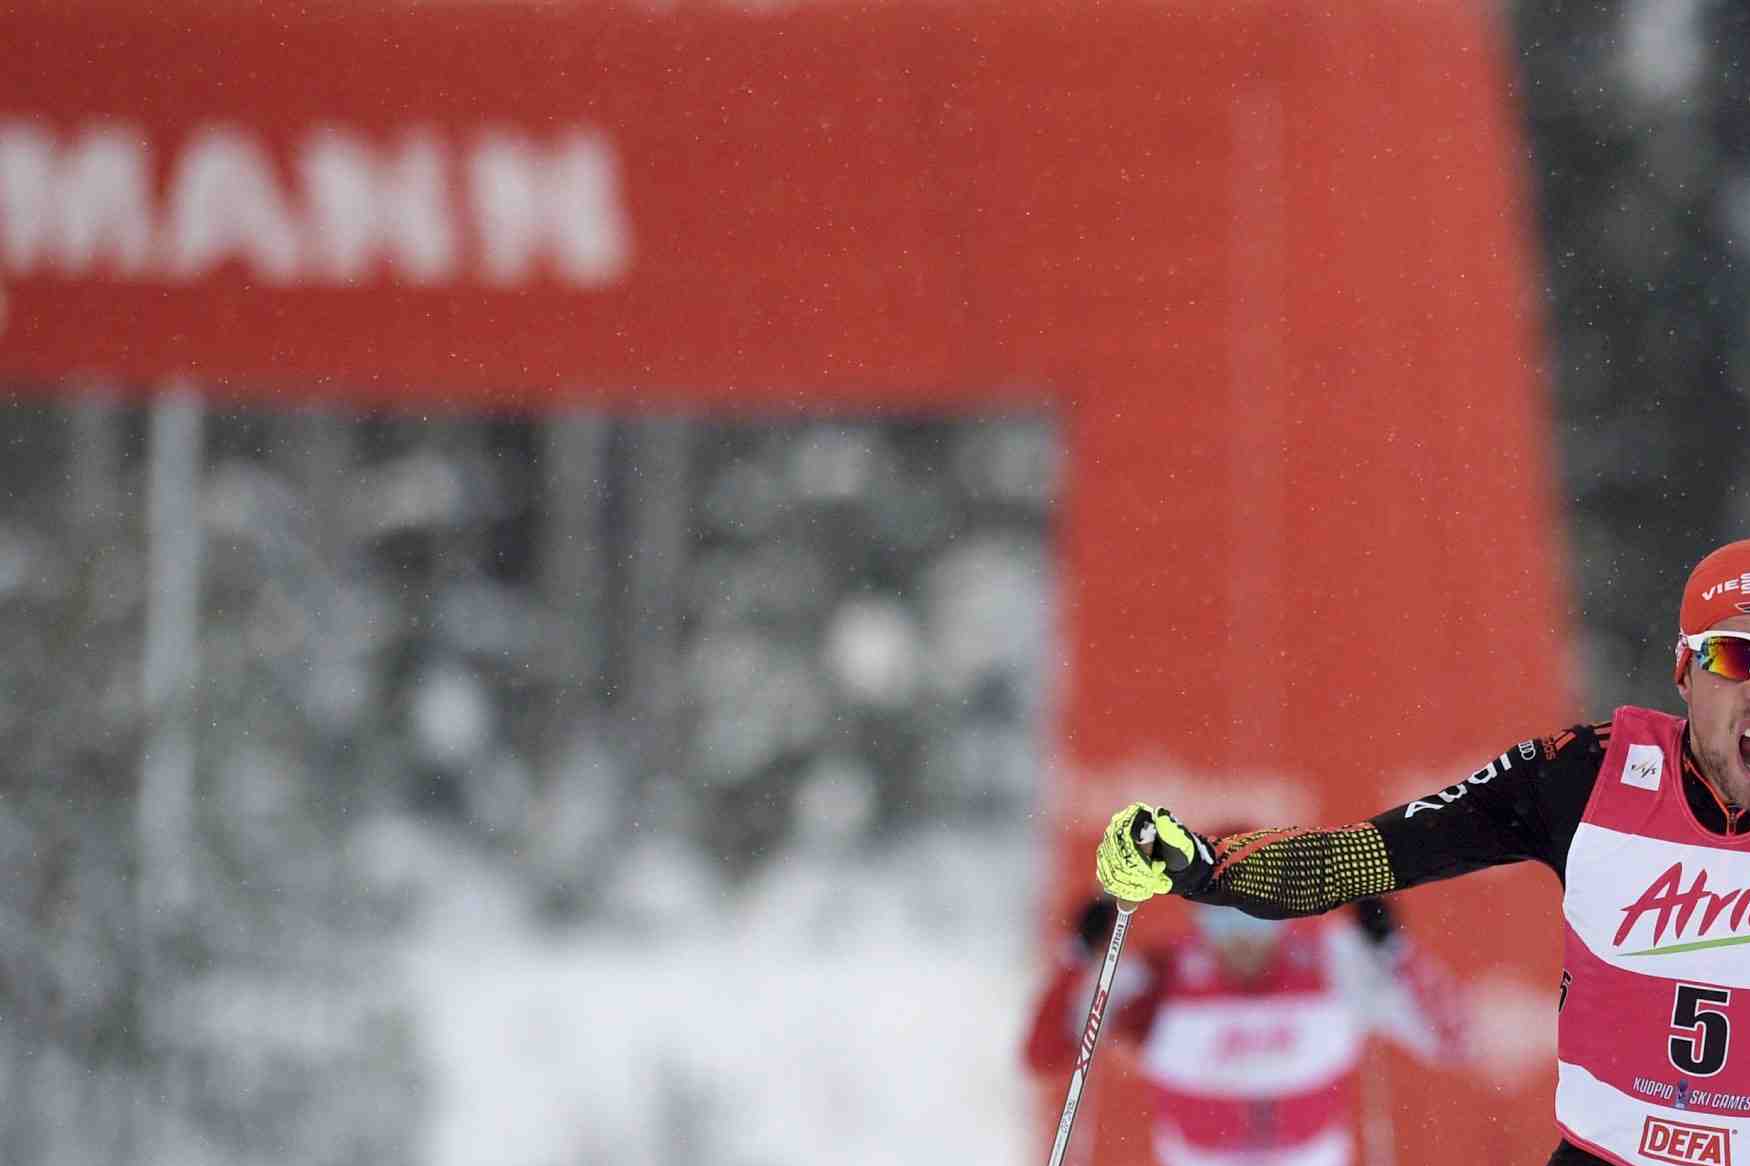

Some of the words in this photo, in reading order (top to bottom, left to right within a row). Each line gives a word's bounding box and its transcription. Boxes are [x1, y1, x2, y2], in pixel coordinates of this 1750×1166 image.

[1668, 982, 1732, 1077] 5
[1633, 1077, 1674, 1101] KUOPIO
[1689, 1090, 1713, 1106] SKI
[1649, 1124, 1721, 1165] DEFA
